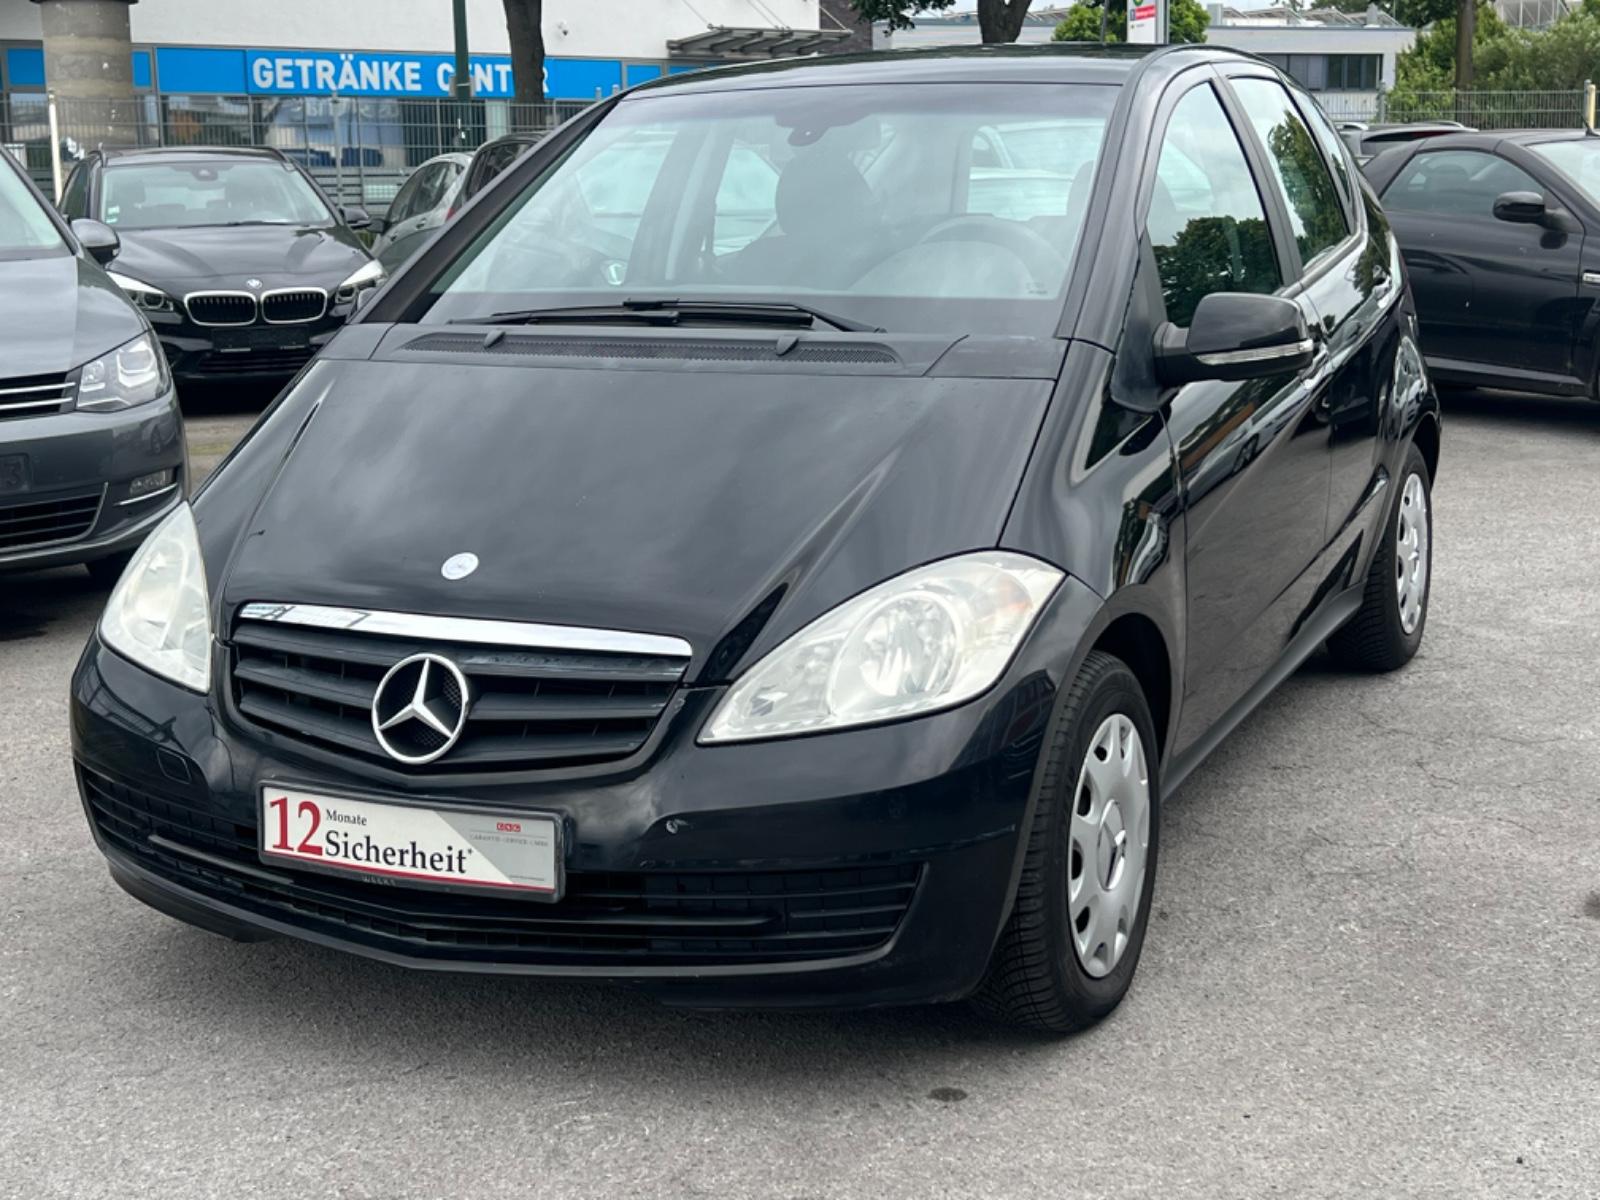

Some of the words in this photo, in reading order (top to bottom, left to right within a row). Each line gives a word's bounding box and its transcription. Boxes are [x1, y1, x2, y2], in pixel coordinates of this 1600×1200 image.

[252, 54, 421, 92] GETRÄNKE
[436, 62, 550, 93] CNT
[269, 796, 323, 856] 12
[326, 808, 367, 826] Monate
